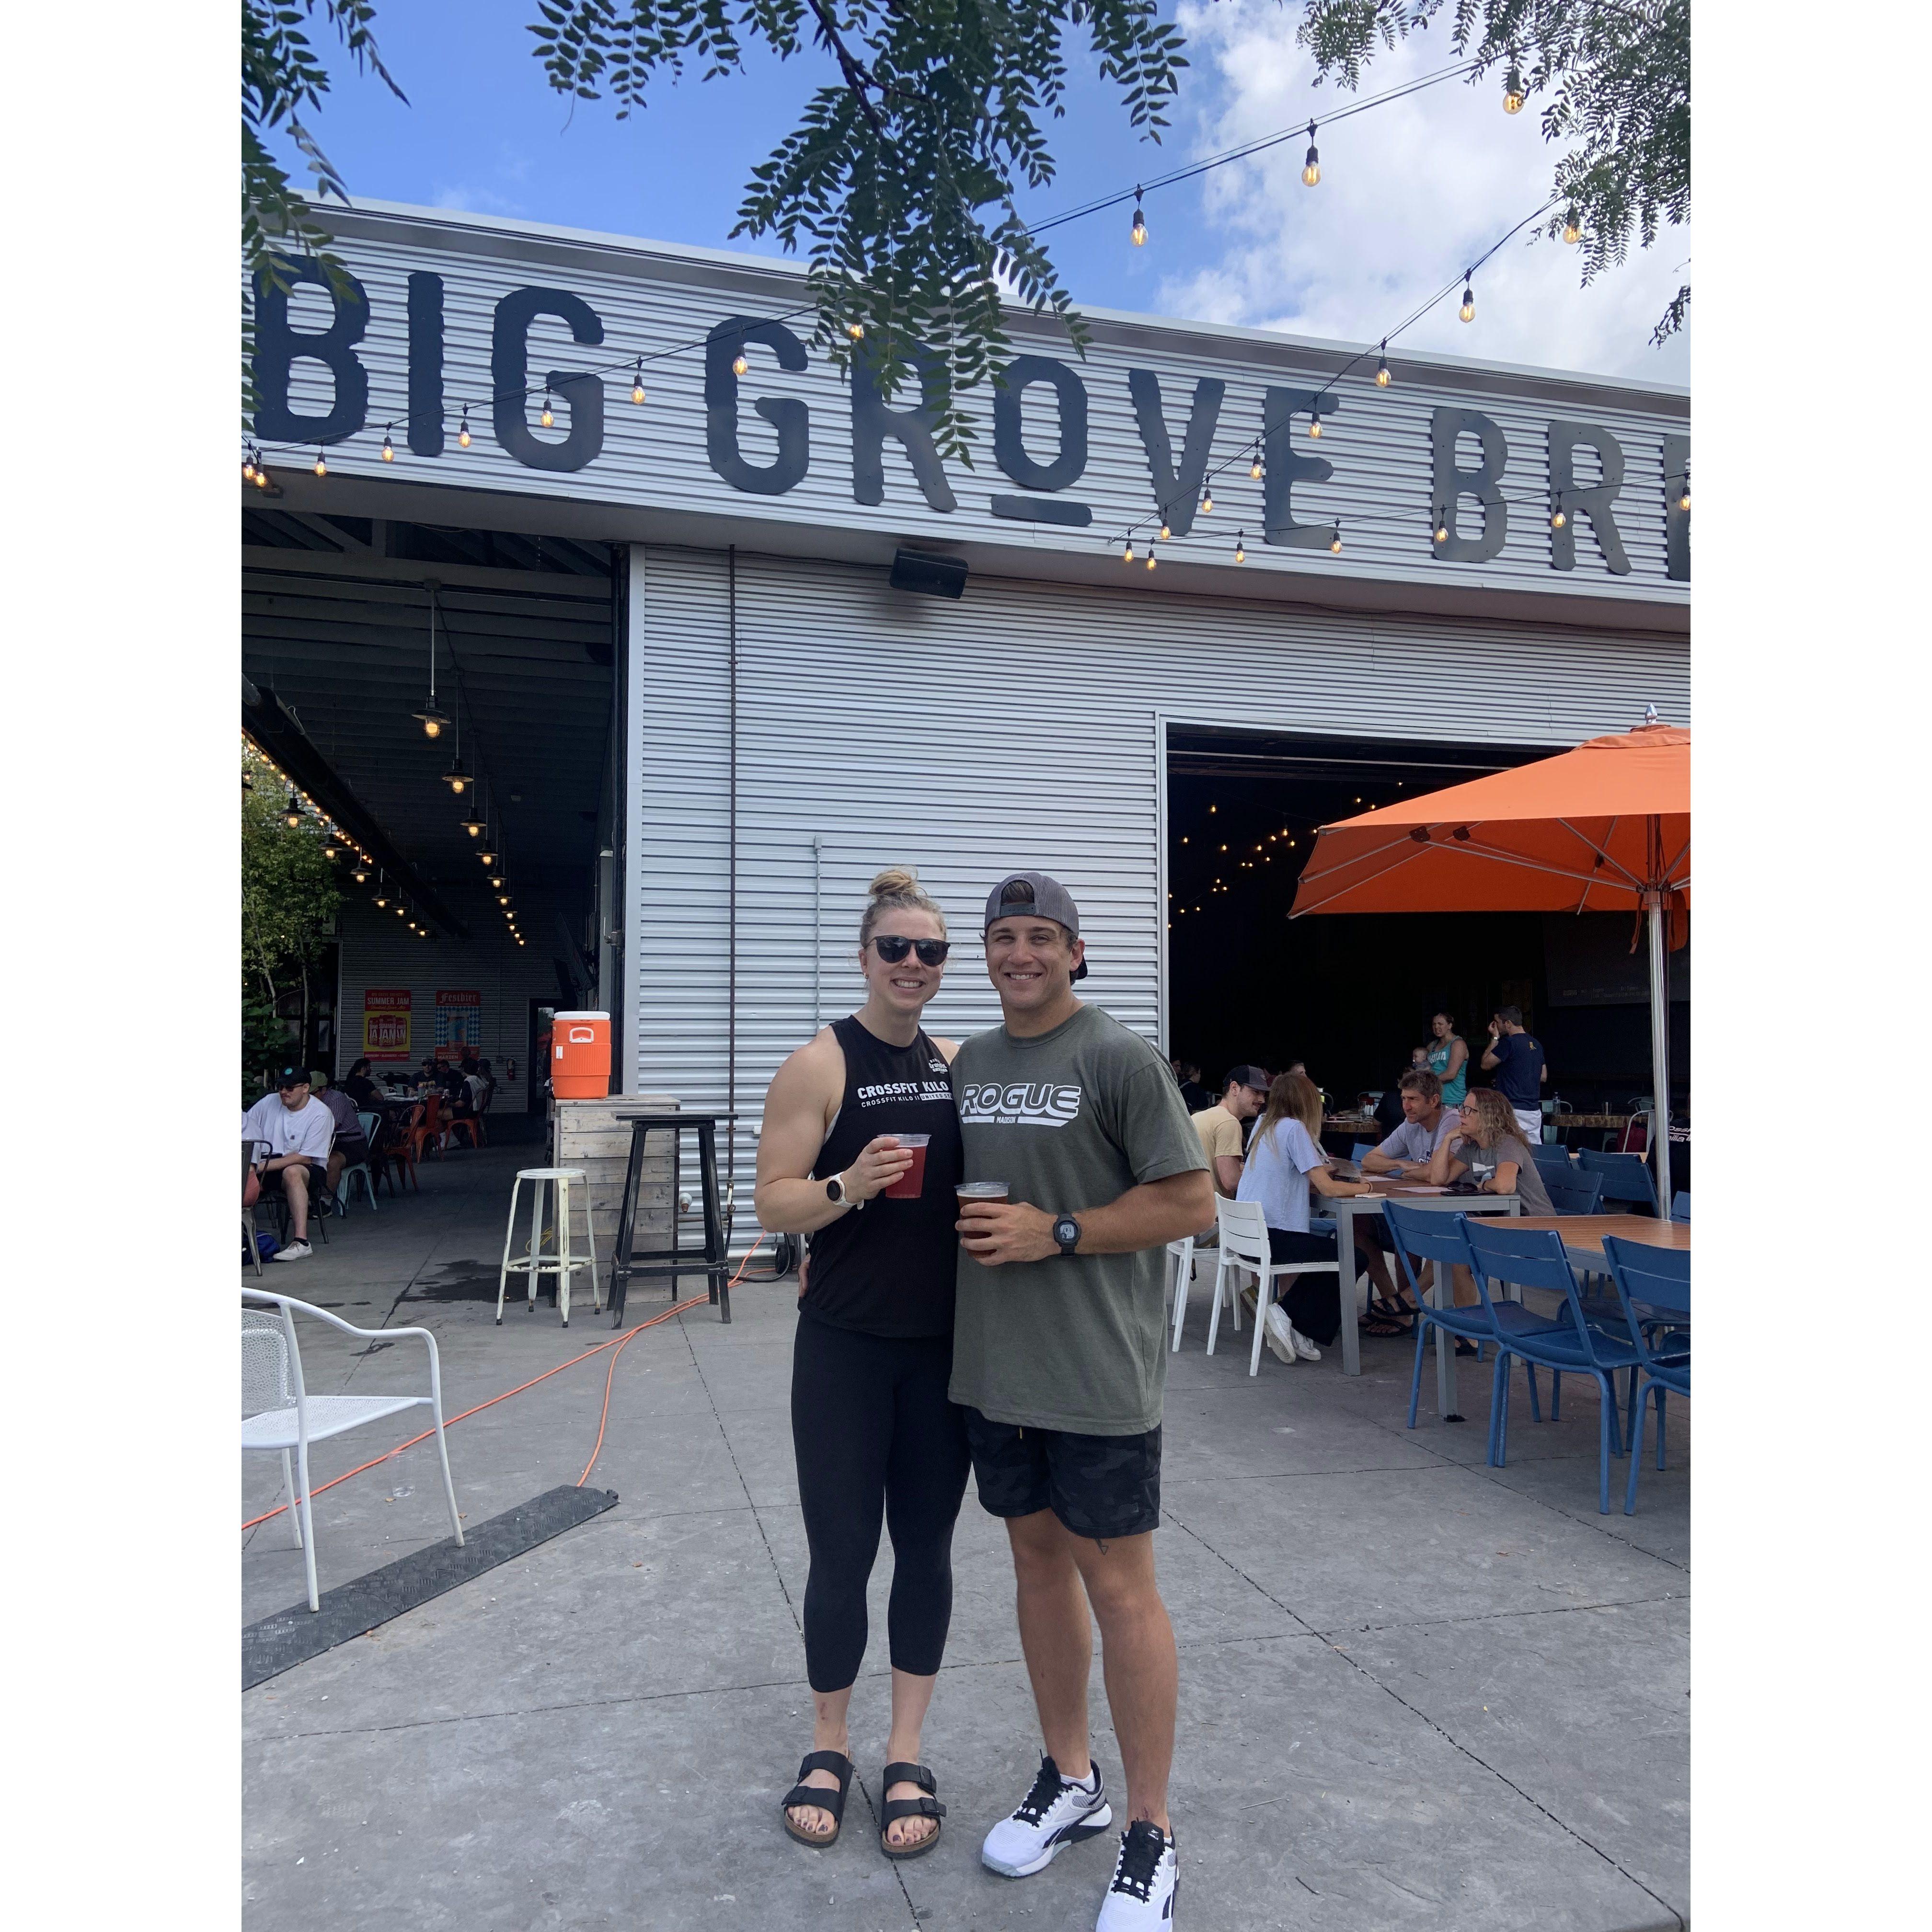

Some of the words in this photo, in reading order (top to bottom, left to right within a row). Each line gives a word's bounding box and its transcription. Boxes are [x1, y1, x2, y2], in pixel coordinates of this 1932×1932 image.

[252, 255, 604, 472] BIG
[705, 316, 1340, 551] GROVE
[439, 993, 477, 1003] Festbier
[857, 1082, 919, 1099] CROSSFIT
[921, 1081, 949, 1092] KILO
[861, 1096, 896, 1108] CROSSFIT
[960, 1083, 1081, 1119] ROGUE
